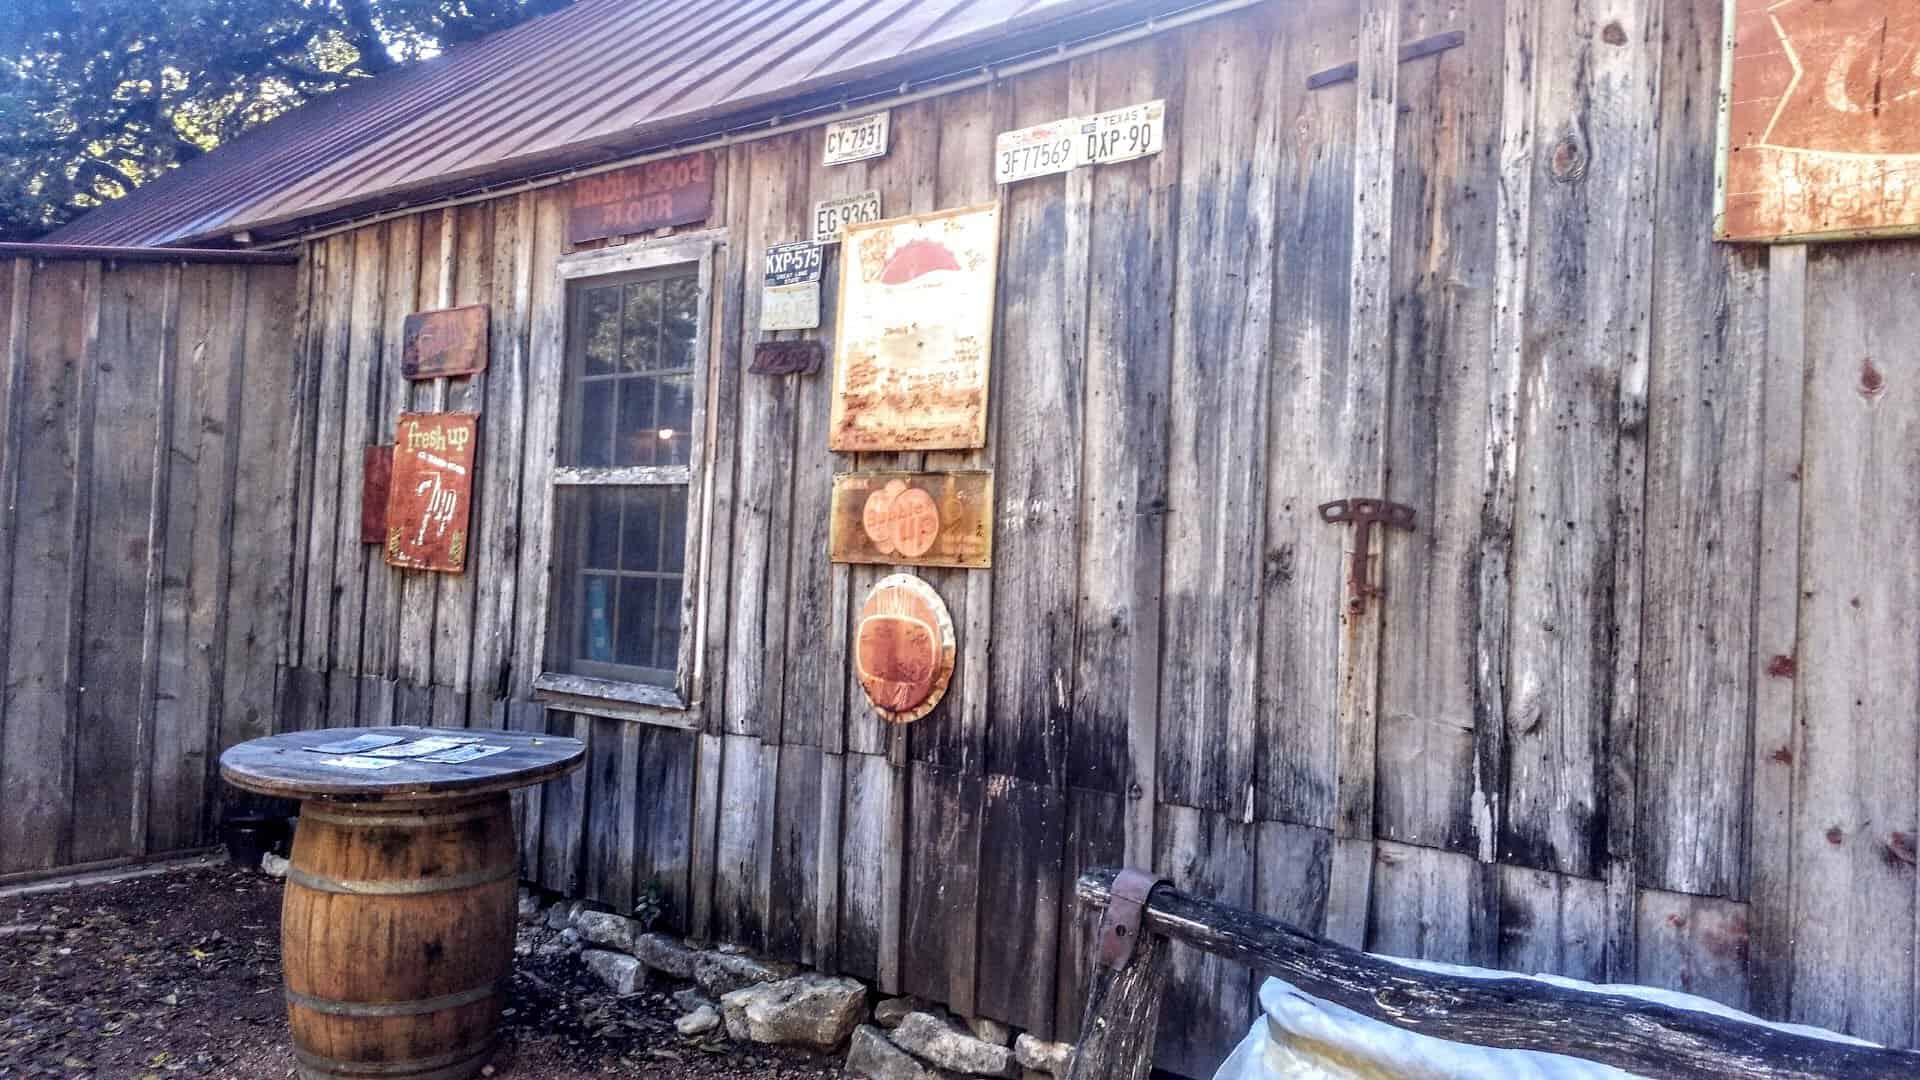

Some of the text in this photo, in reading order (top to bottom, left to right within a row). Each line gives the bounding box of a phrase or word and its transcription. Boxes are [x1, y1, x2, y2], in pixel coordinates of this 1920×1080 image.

[1103, 110, 1138, 126] TEXAS
[1001, 138, 1071, 174] 3F77569
[817, 209, 836, 234] EG
[406, 420, 447, 452] fresh
